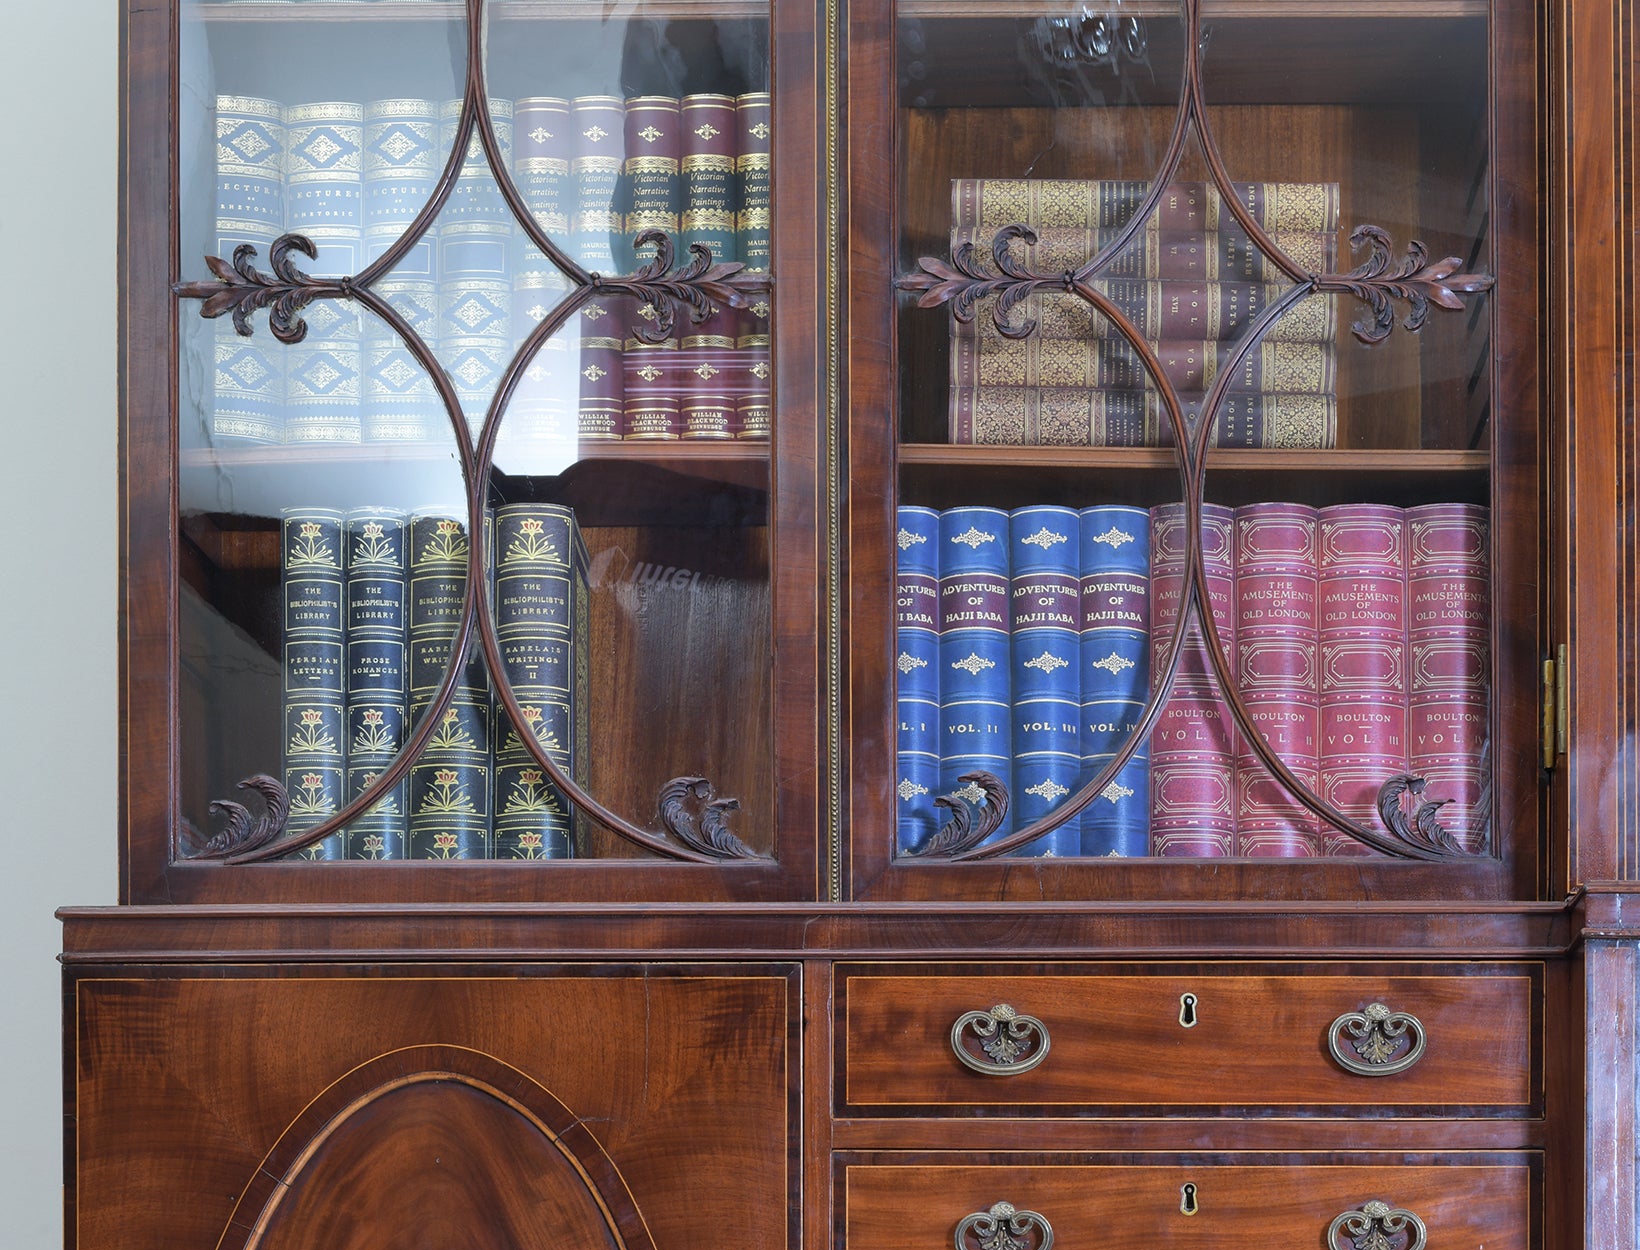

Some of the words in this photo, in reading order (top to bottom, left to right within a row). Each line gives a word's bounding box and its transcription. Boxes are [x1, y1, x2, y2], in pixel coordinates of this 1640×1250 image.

[634, 174, 669, 184] Victorian
[690, 172, 725, 182] Victorian
[633, 187, 670, 197] Narrative
[690, 185, 726, 195] Narrative
[634, 200, 669, 211] Paintings
[690, 198, 725, 208] Paintings
[1229, 289, 1238, 325] POETS
[1227, 400, 1236, 438] POETS
[365, 586, 382, 594] THE
[439, 584, 457, 592] THE
[523, 583, 541, 591] THE
[942, 583, 1006, 597] ADVENTURES
[1083, 583, 1145, 595] ADVENTURES
[1268, 581, 1293, 590] THE
[1352, 583, 1377, 591] THE
[1441, 583, 1466, 591] THE
[304, 587, 321, 595] THE
[1012, 584, 1078, 598] ADVENTURES
[967, 597, 984, 606] OF
[1038, 597, 1056, 606] OF
[1108, 596, 1124, 605] OF
[1242, 590, 1313, 603] AMUSEMENTS
[1324, 592, 1399, 604] AMUSEMENTS
[897, 598, 914, 607] OF
[1272, 600, 1287, 608] OF
[1356, 601, 1371, 609] OF
[1445, 601, 1460, 609] OF
[295, 612, 331, 620] LIBRARY
[356, 611, 395, 620] LIBRARY
[511, 608, 555, 616] LIBRARY
[946, 611, 974, 623] HAJJI
[976, 611, 1003, 623] BABA
[1087, 611, 1115, 622] HAJJI
[1117, 611, 1142, 622] BABA
[1242, 610, 1263, 620] OLD
[1267, 609, 1311, 620] LONDON
[1325, 611, 1347, 622] OLD
[1351, 610, 1397, 622] LONDON
[1415, 611, 1437, 622] OLD
[1441, 609, 1484, 622] LONDON
[906, 612, 933, 625] BABA
[1016, 612, 1045, 624] HAJJI
[1048, 612, 1075, 624] BABA
[505, 645, 561, 654] RABELAIS
[290, 656, 338, 665] PERSIAN
[360, 657, 391, 665] PROSE
[508, 656, 559, 664] WRITINGS
[293, 667, 334, 675] LETTERS
[352, 666, 399, 675] ROMANCES
[529, 672, 537, 680] II
[1168, 709, 1220, 719] BOULTON
[1252, 712, 1305, 722] BOULTON
[1336, 713, 1391, 723] BOULTON
[1426, 713, 1480, 722] BOULTON
[949, 724, 981, 734] VOL.
[987, 724, 998, 734] II
[1023, 722, 1057, 733] VOL.
[1062, 723, 1077, 733] III
[1090, 723, 1120, 733] VOL.
[1161, 730, 1207, 741] VOL.
[1306, 735, 1312, 746] II
[1328, 733, 1375, 745] VOL.
[1389, 735, 1399, 746] III
[1418, 733, 1464, 744] VOL.
[1475, 735, 1484, 745] IV
